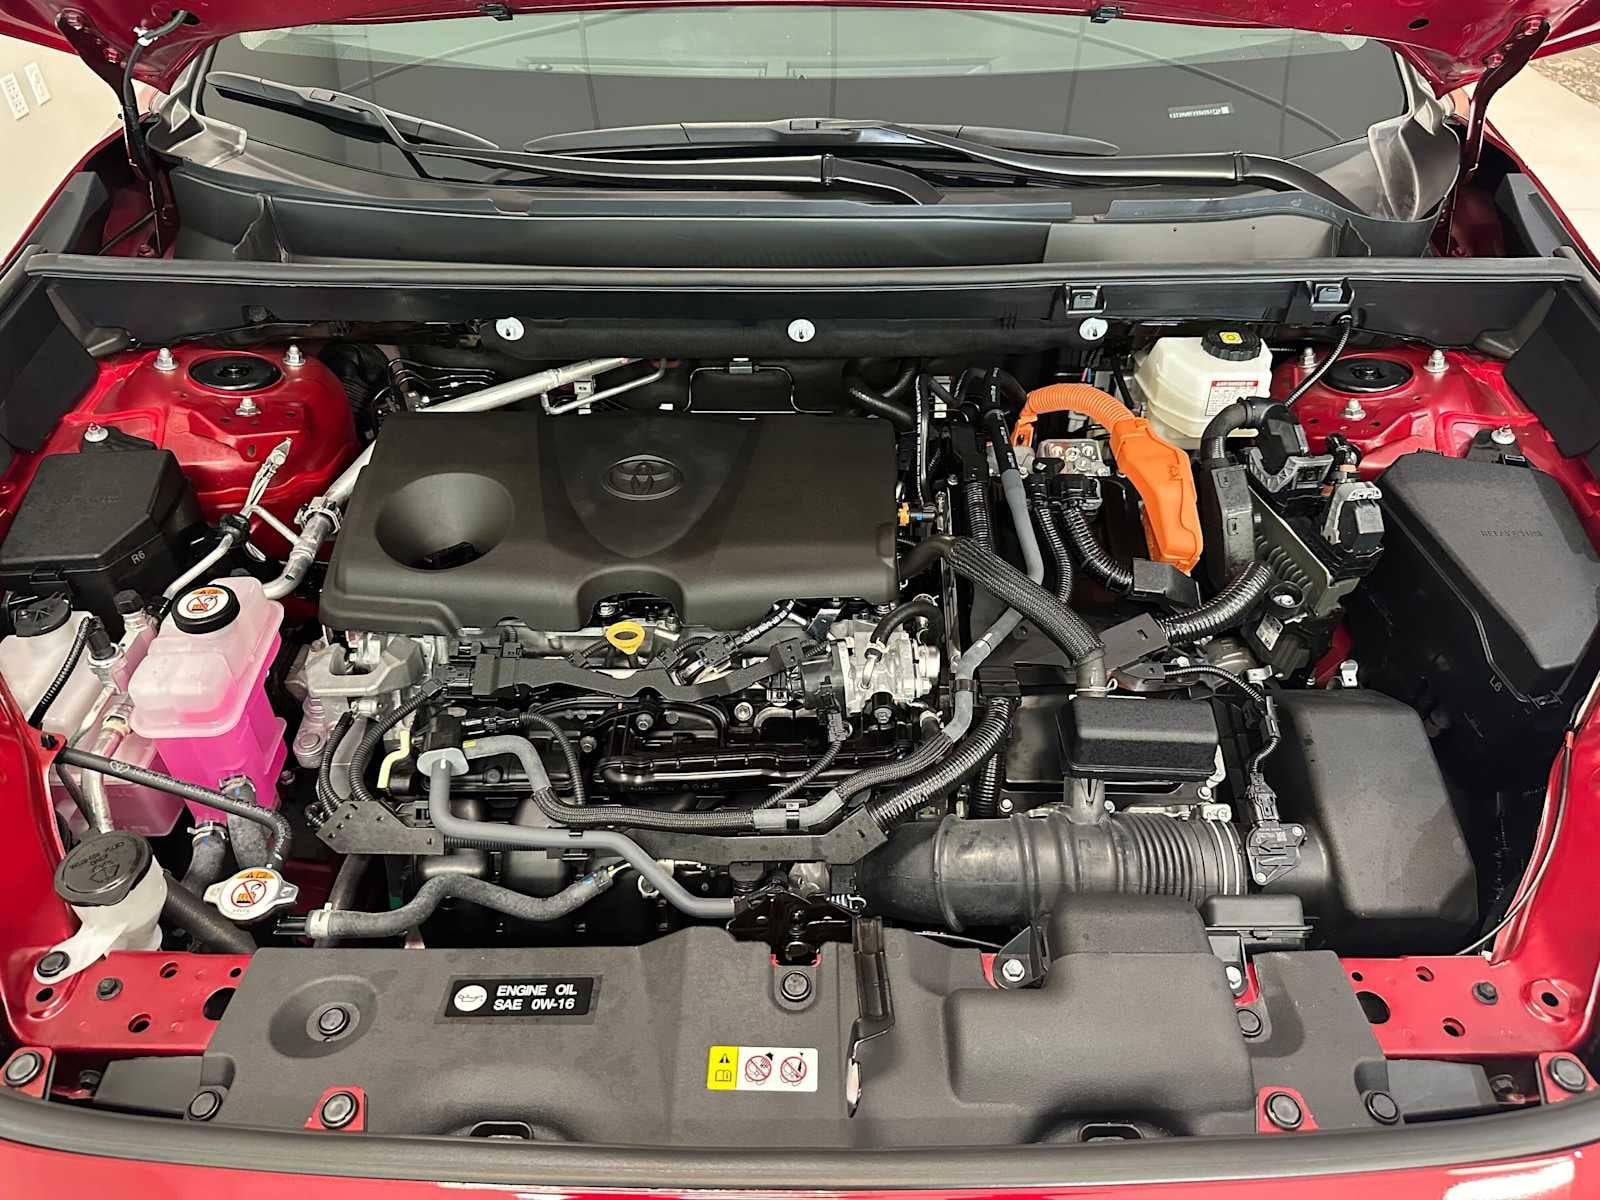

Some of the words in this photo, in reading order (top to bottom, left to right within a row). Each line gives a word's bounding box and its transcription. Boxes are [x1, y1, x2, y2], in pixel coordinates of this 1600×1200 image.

[131, 550, 146, 565] R6
[496, 984, 548, 997] ENGINE
[554, 983, 578, 996] OIL
[493, 998, 523, 1011] SAE
[531, 997, 576, 1010] 0W-16
